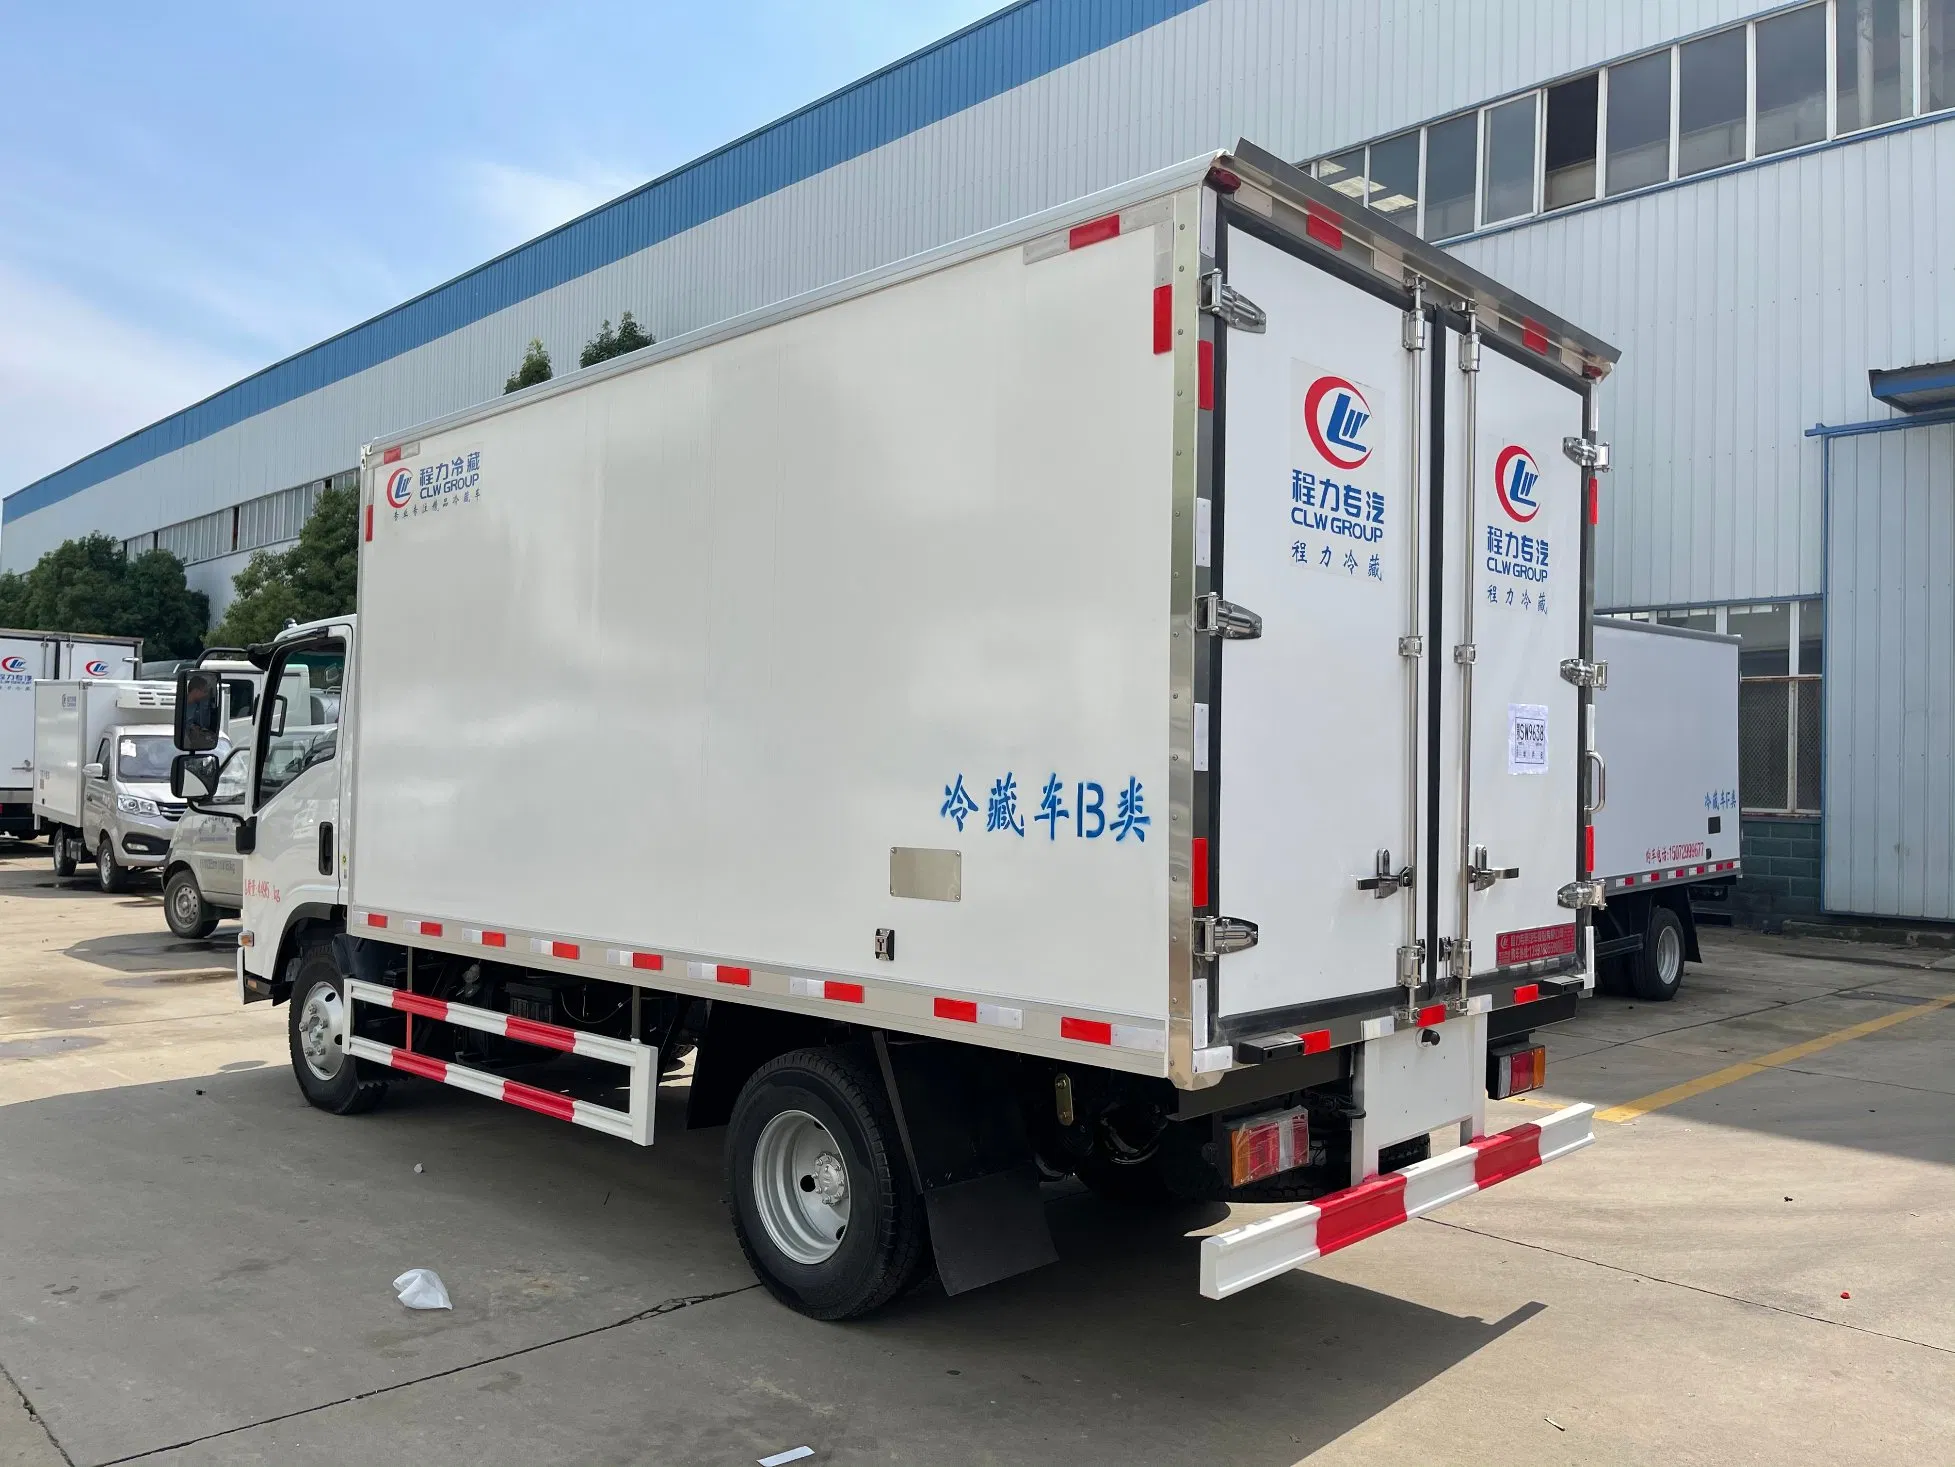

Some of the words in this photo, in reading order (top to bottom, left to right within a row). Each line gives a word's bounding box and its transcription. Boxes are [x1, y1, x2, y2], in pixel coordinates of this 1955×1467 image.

[419, 451, 481, 487] 程力冷藏
[420, 482, 442, 499] CLW
[443, 473, 480, 494] GROUP
[1292, 468, 1385, 525] 程力专汽
[1291, 506, 1328, 531] CLW
[1330, 516, 1384, 543] GROUP
[1291, 540, 1383, 582] 程力冷藏
[1487, 525, 1549, 567] 程力专汽
[1486, 556, 1511, 576] CLW
[1512, 563, 1548, 583] GROUP
[1487, 584, 1548, 615] 程力冷藏
[940, 771, 1151, 843] 冷藏车B类
